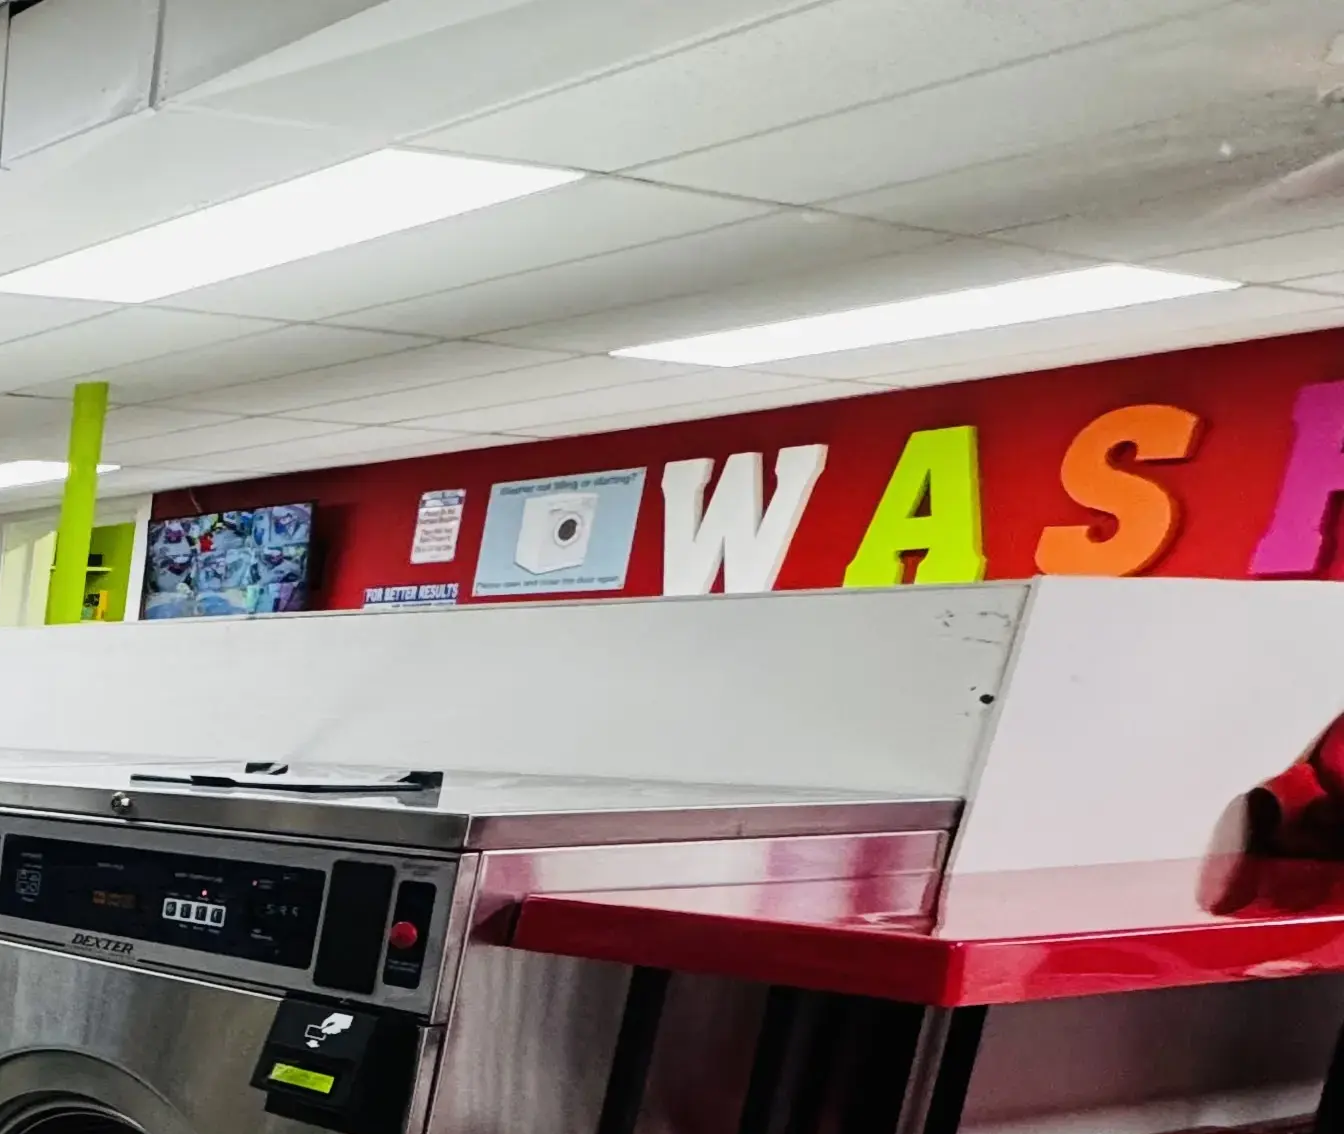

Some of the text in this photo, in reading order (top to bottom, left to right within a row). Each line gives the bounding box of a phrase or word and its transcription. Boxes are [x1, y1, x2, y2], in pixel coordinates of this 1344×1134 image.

[364, 583, 459, 603] FOR BETTER RESULTS
[71, 933, 134, 955] DEXTER
